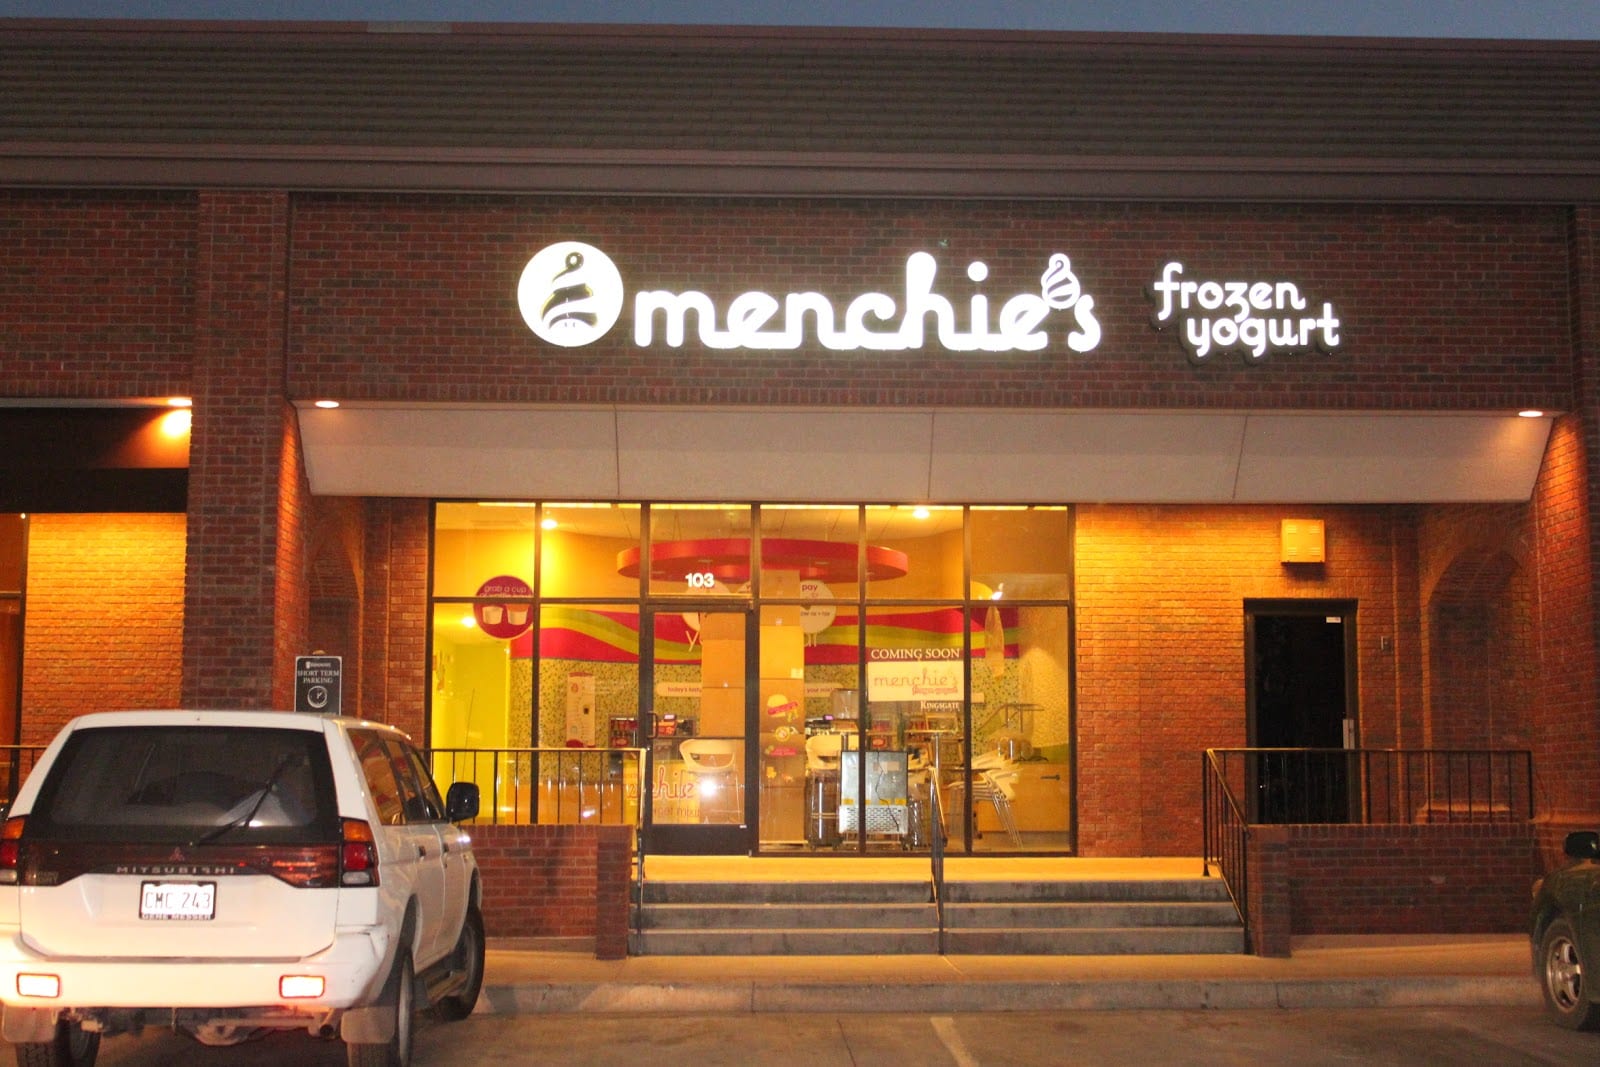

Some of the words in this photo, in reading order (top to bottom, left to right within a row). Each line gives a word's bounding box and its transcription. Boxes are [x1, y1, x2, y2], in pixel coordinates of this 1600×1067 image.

[1154, 262, 1306, 323] frozen
[634, 252, 1100, 351] menchie's
[1187, 303, 1339, 357] yogurt
[685, 572, 714, 588] 103
[802, 584, 818, 592] pay
[870, 648, 922, 660] COMING
[925, 648, 960, 659] SOON
[873, 667, 959, 687] menchie's
[920, 701, 961, 710] KINGSGATE
[117, 866, 235, 874] MITSUBISHI
[145, 892, 174, 909] CMC
[182, 892, 211, 909] 243
